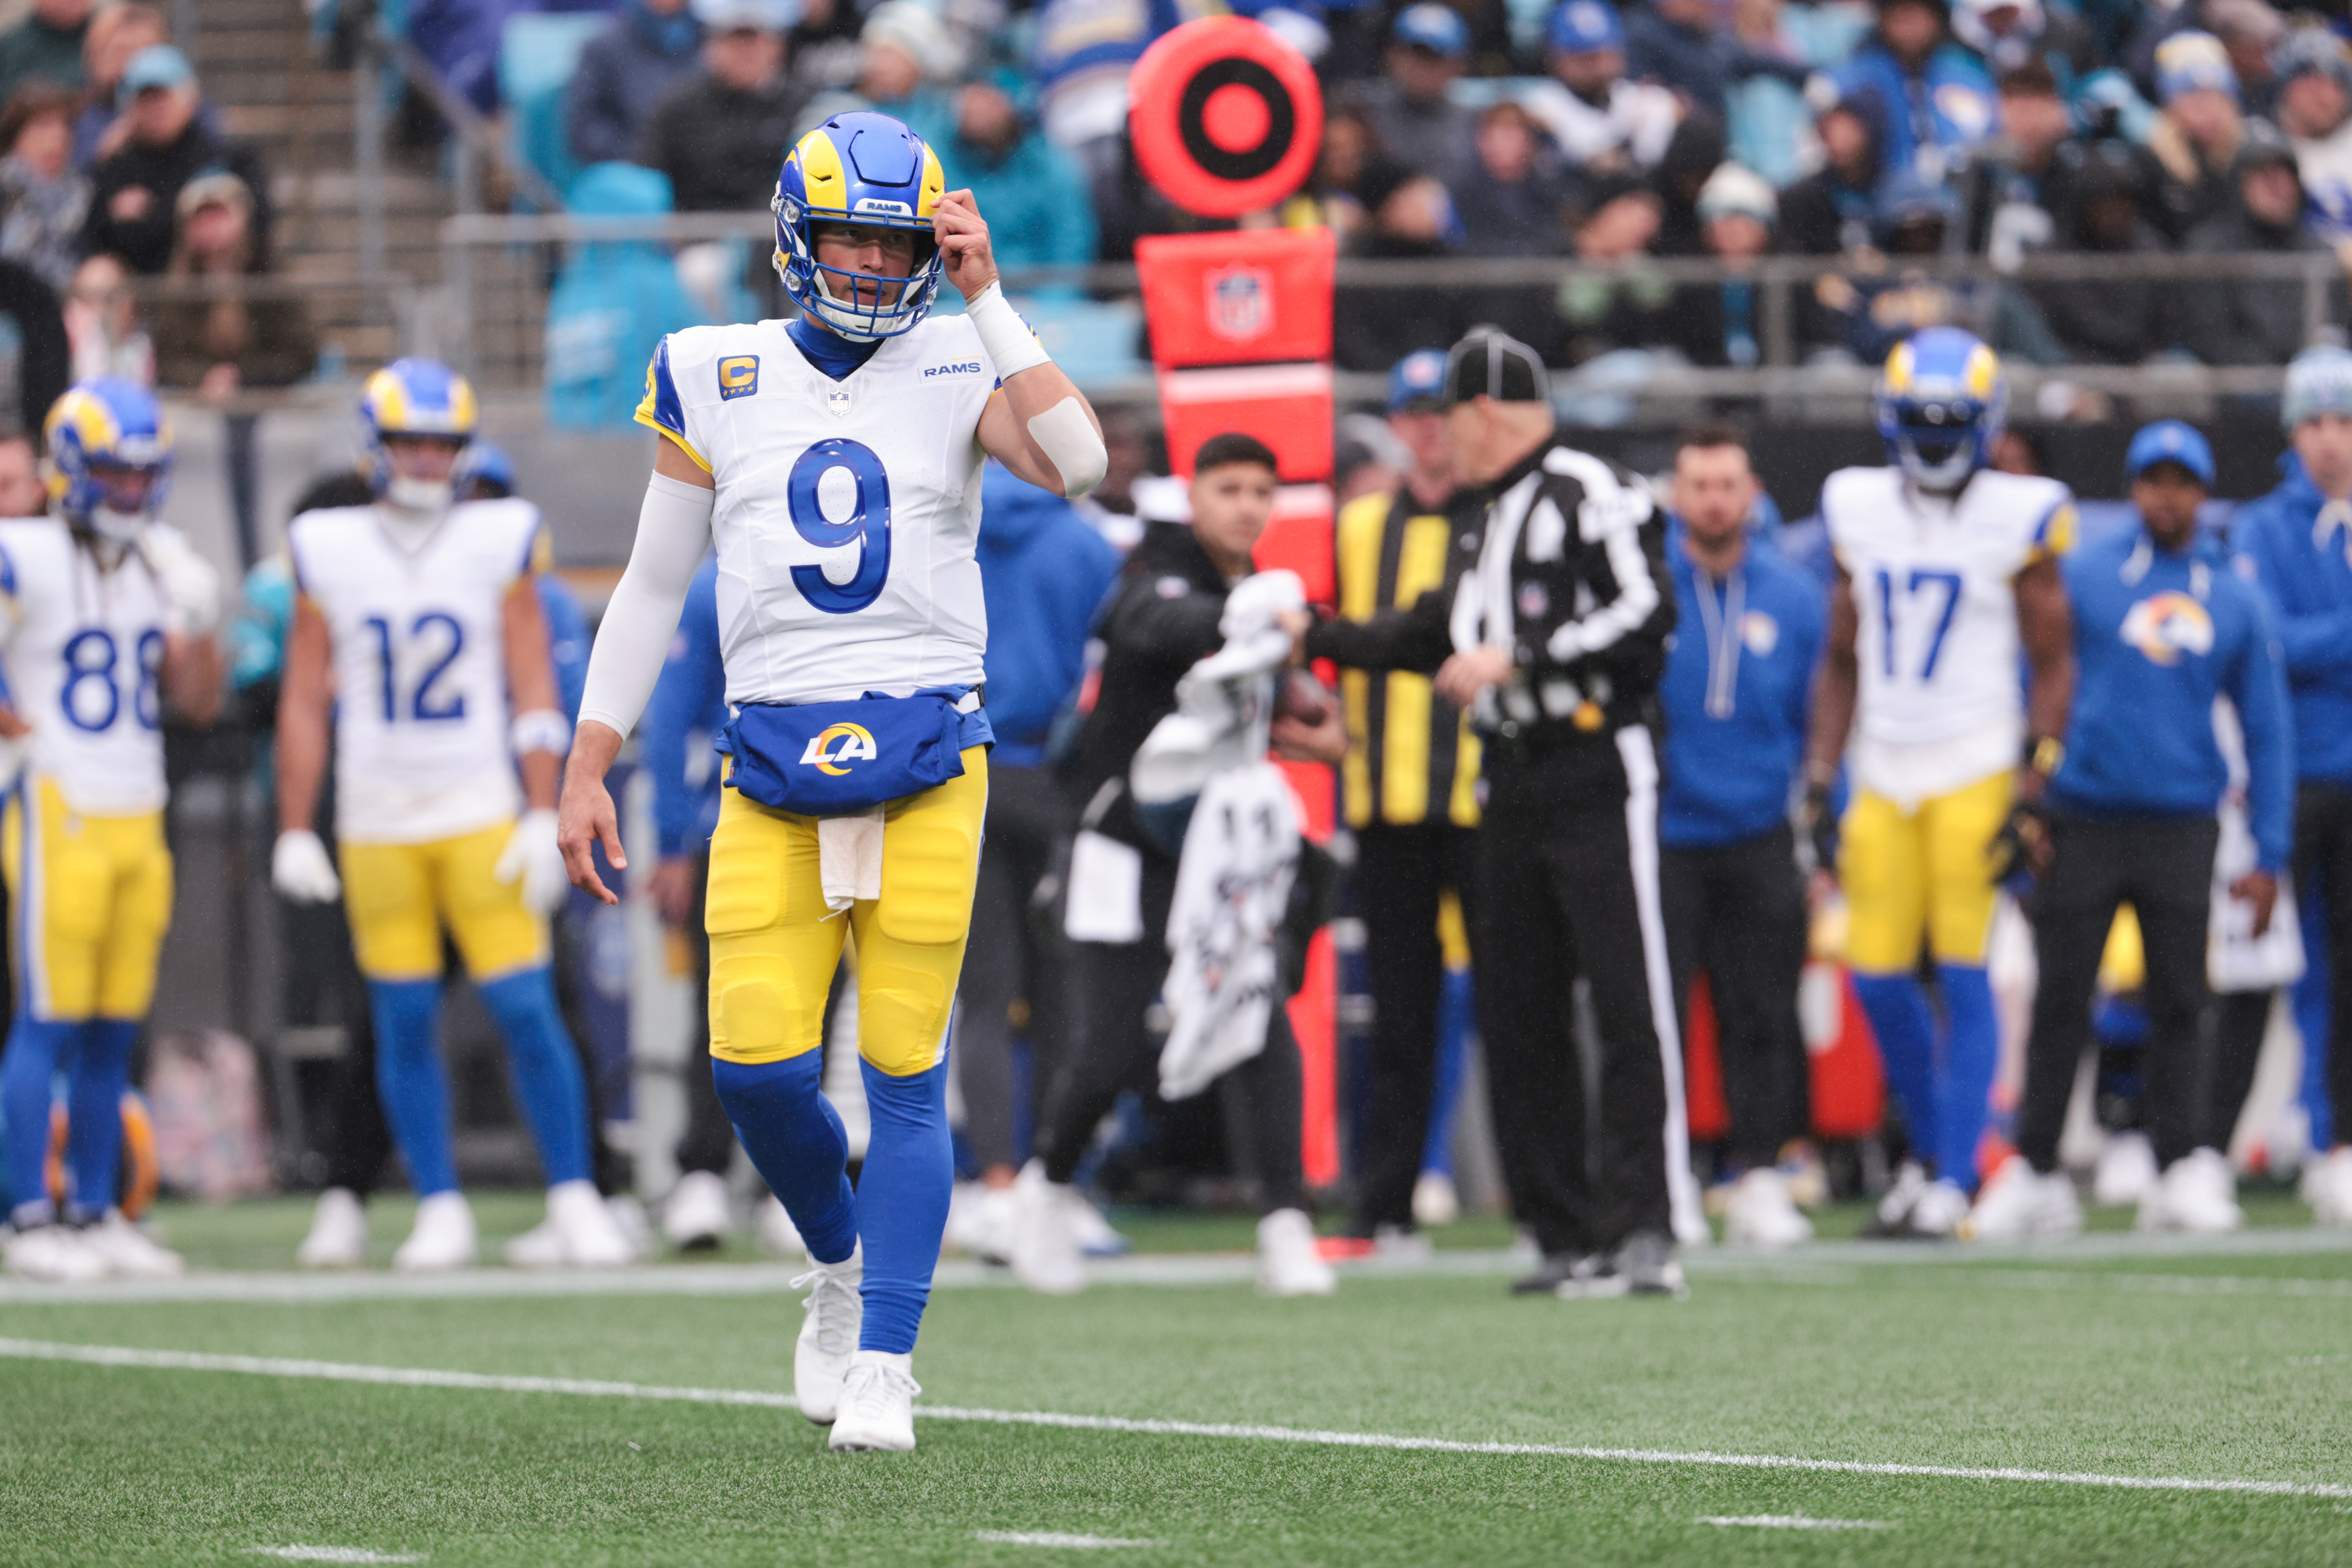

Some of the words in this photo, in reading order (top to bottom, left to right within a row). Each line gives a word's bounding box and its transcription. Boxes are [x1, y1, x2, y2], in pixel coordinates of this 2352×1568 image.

[867, 202, 902, 212] RAMS
[721, 357, 756, 388] C
[924, 362, 980, 377] RAMS
[787, 438, 891, 614] 9
[1876, 571, 1961, 679] 17
[367, 614, 464, 722] 12
[799, 723, 877, 764] LA
